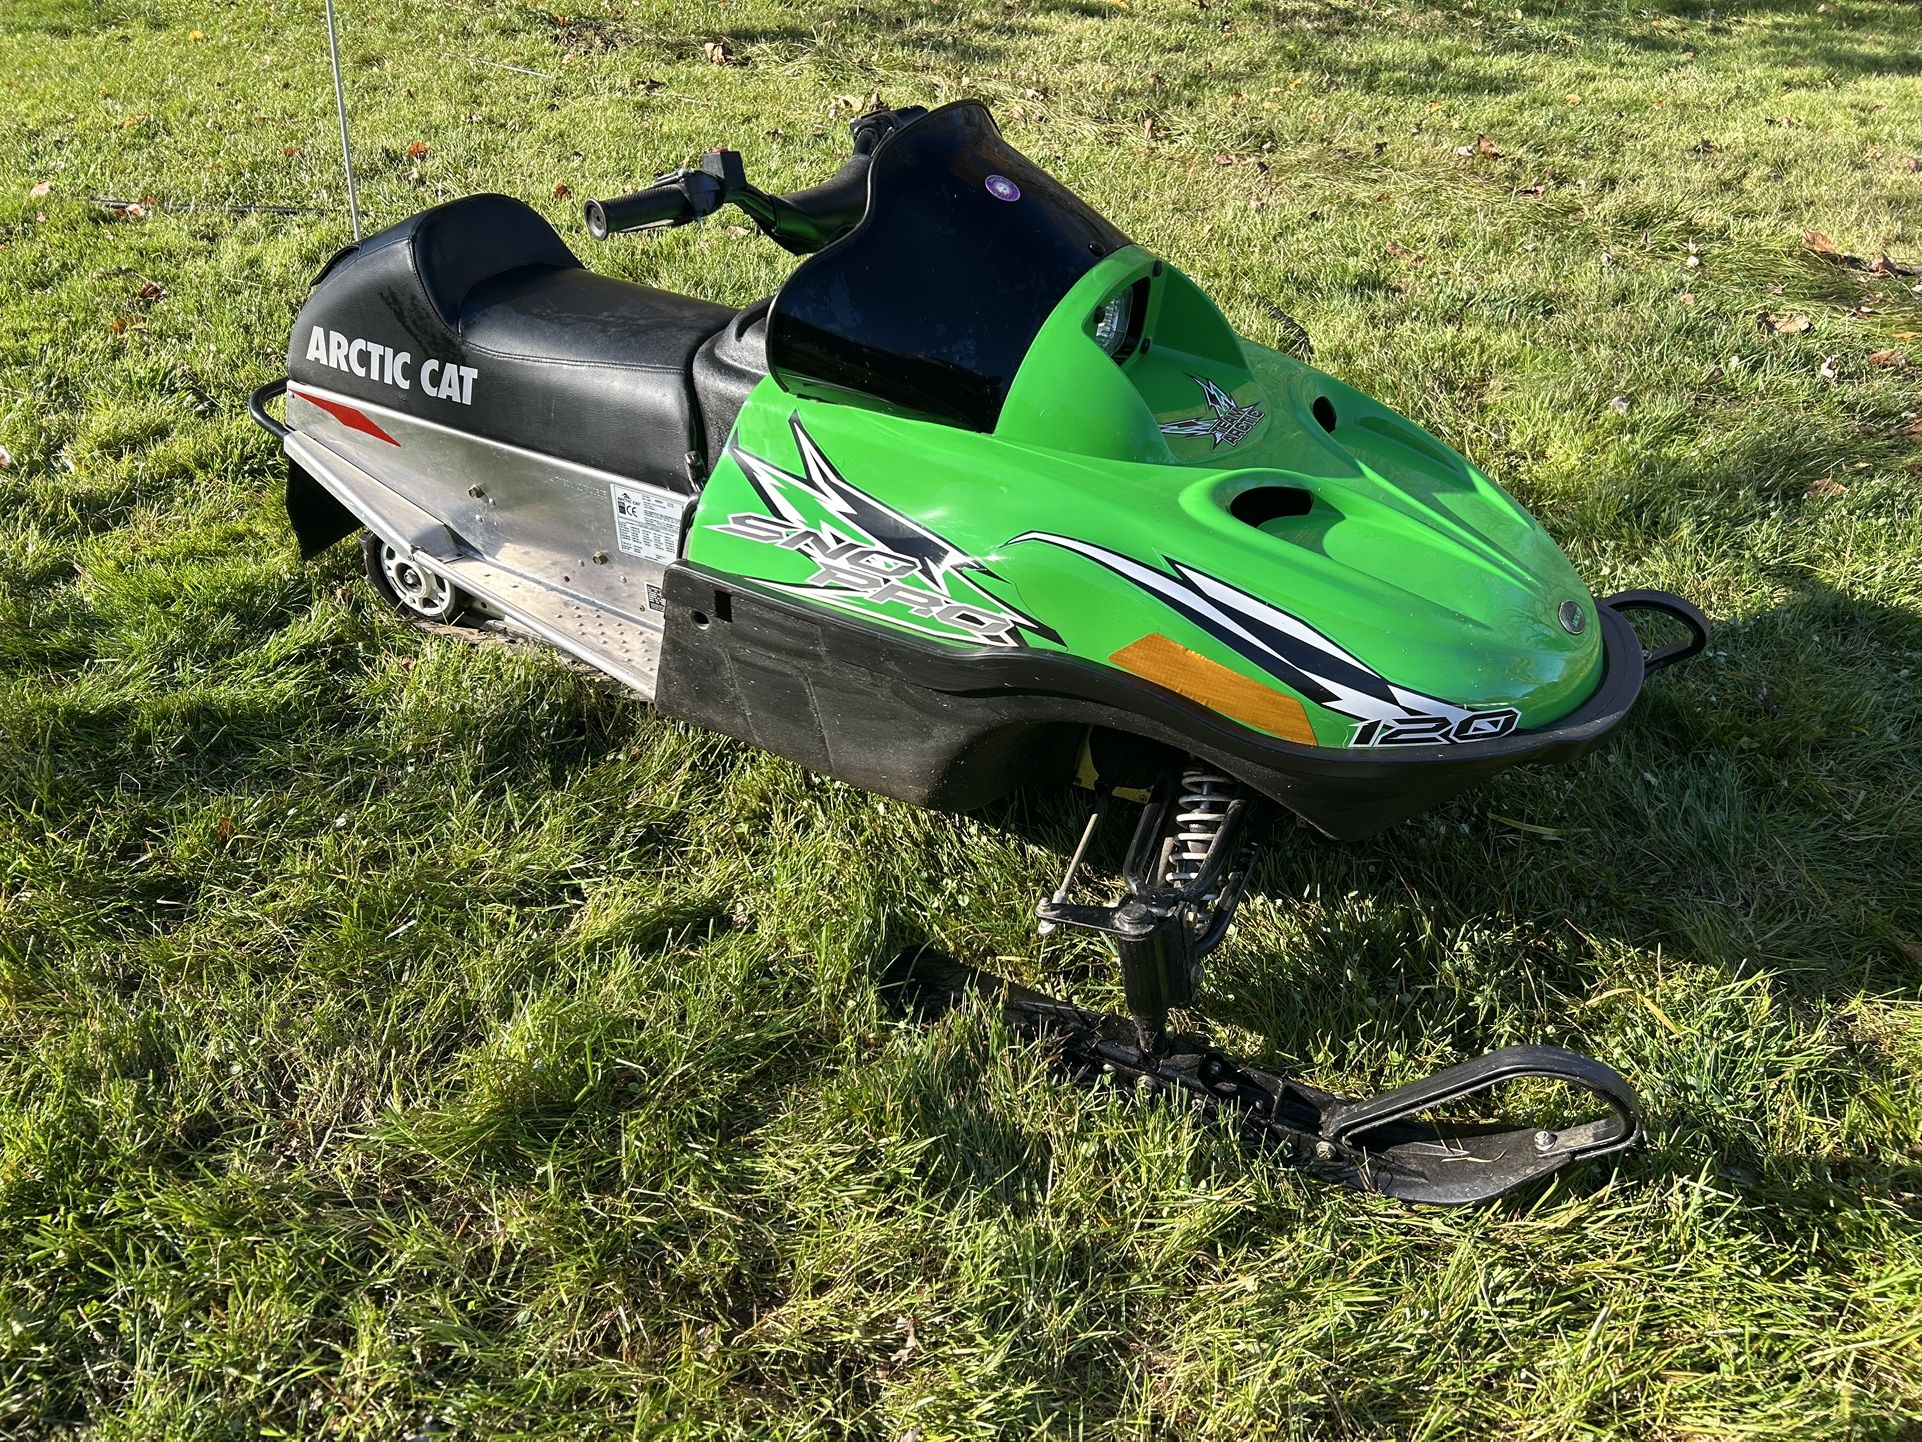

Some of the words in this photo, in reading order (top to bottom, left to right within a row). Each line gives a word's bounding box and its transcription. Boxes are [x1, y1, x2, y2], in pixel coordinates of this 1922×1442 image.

[306, 325, 411, 390] ARCTIC
[420, 358, 479, 406] CAT
[1209, 407, 1244, 437] TEAM
[1221, 408, 1265, 447] ARCTIC
[702, 512, 922, 580] SNO
[805, 562, 1015, 635] PRO
[1348, 707, 1521, 748] 120
